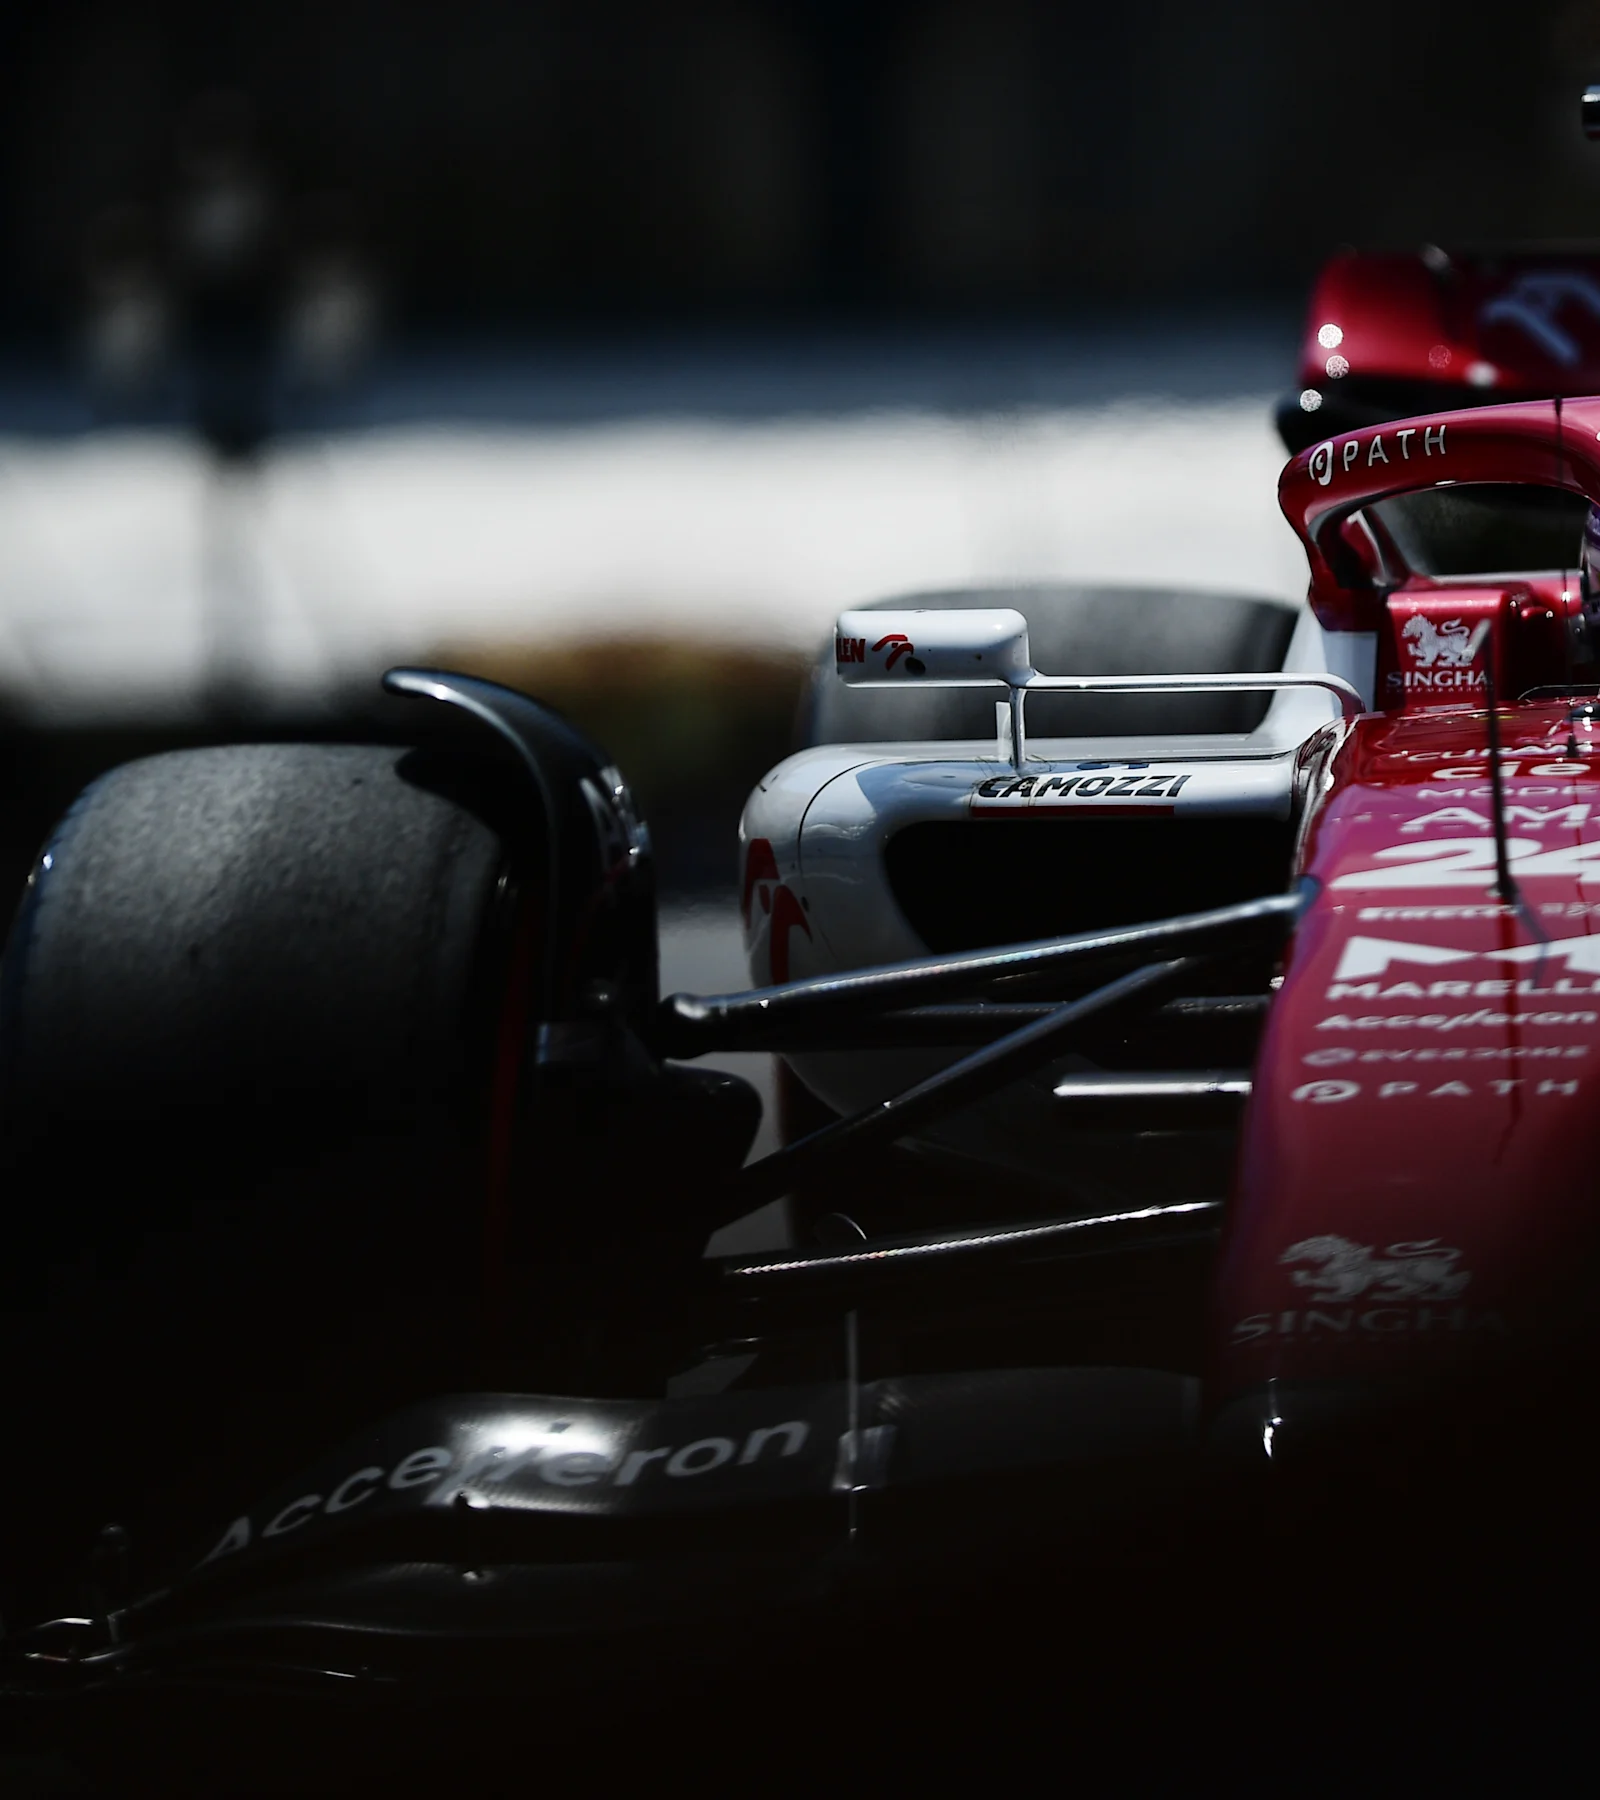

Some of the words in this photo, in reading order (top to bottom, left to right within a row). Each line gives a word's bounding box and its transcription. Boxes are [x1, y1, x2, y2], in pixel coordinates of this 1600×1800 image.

[1343, 425, 1448, 472] PATH
[1385, 670, 1493, 688] SINGHA
[978, 774, 1192, 798] CAMOZZI
[1377, 1078, 1581, 1098] PATH
[1231, 1307, 1511, 1346] SINGHA
